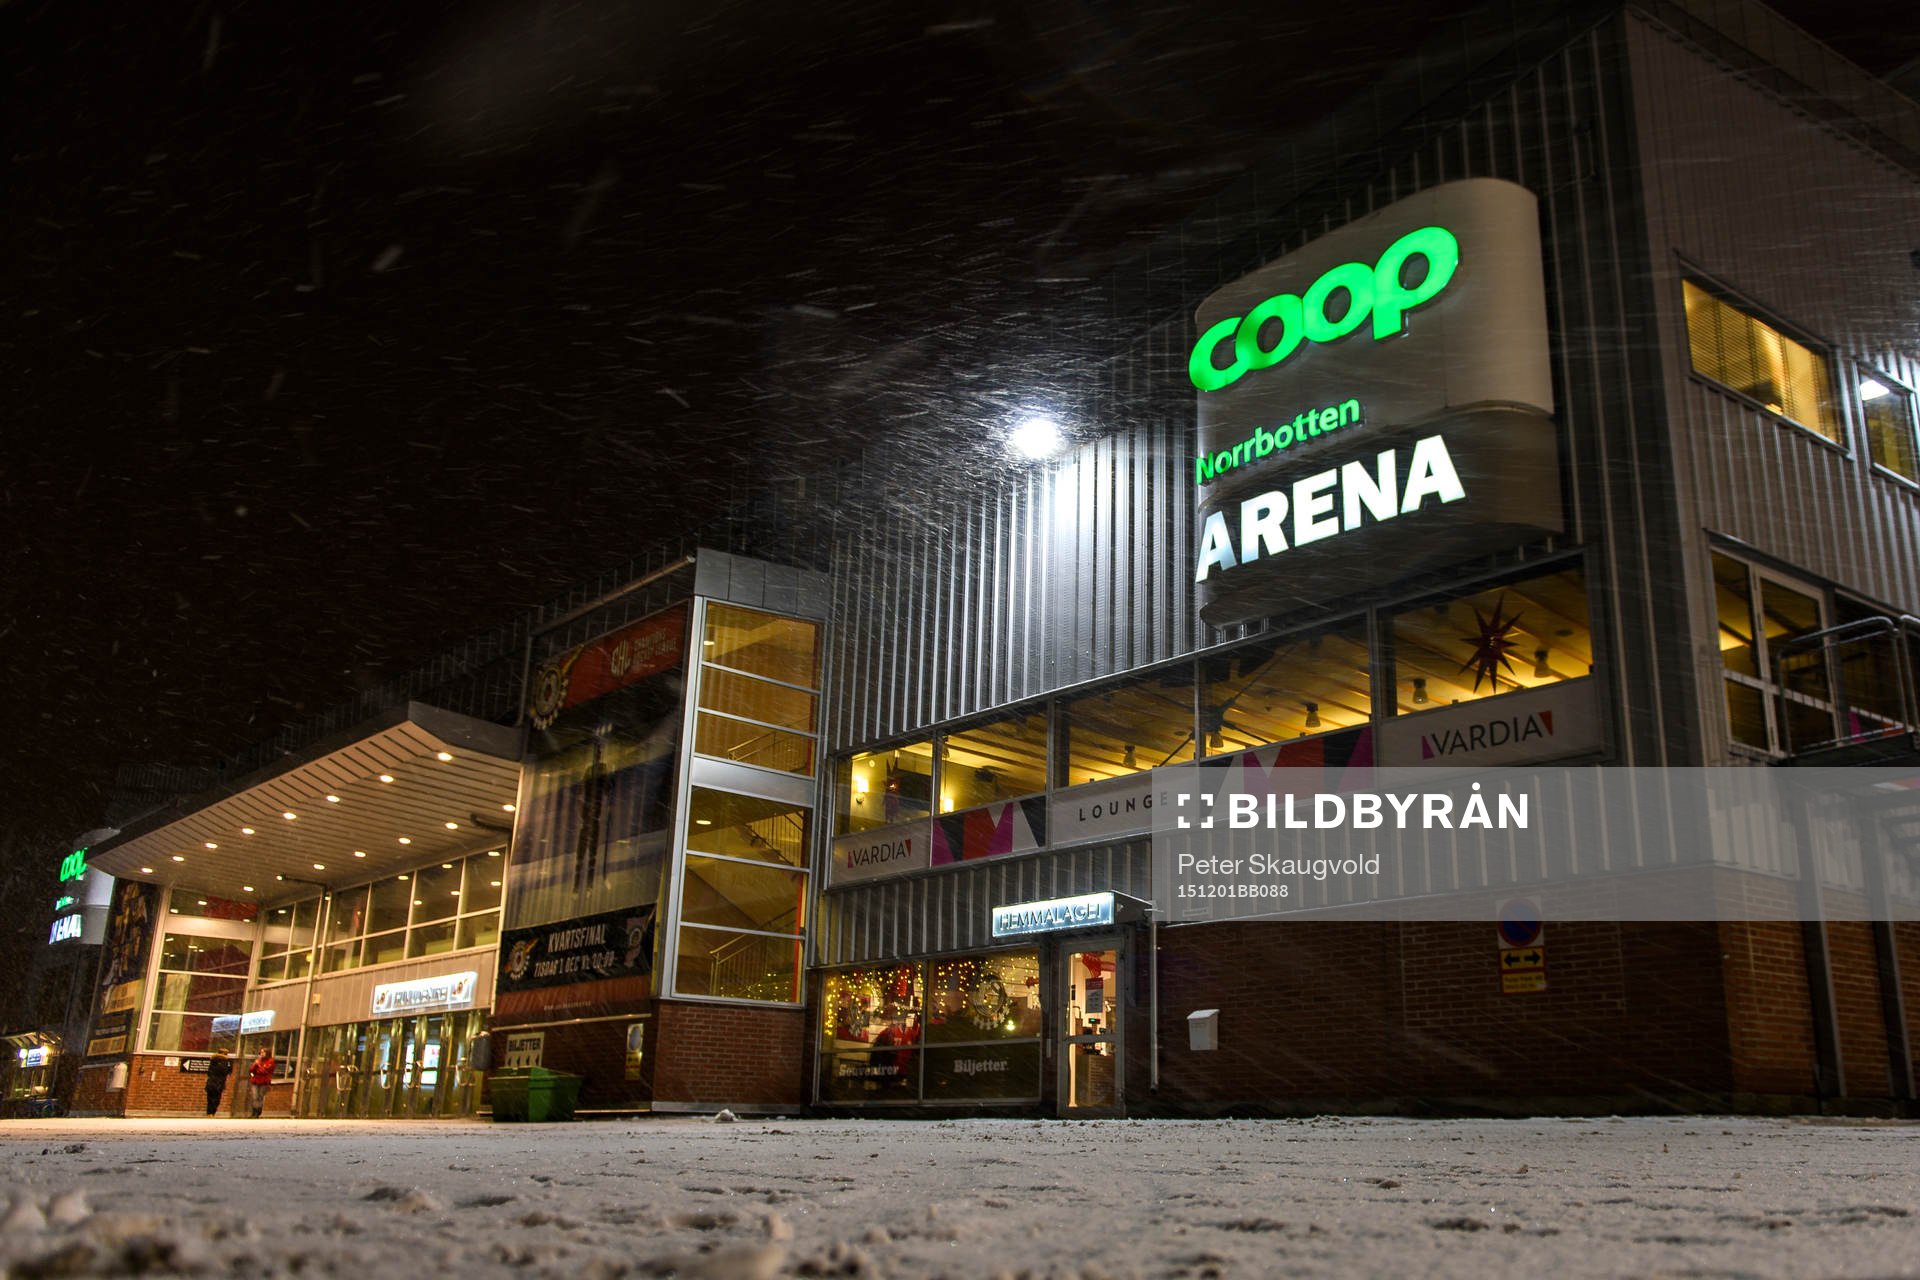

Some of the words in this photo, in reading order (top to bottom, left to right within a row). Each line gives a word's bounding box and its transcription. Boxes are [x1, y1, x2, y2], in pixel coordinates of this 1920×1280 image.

[1189, 226, 1459, 391] coop
[1196, 399, 1360, 486] Norrbotten
[1195, 435, 1466, 582] ARENA
[1430, 714, 1544, 756] VARDIA
[1079, 791, 1168, 822] LOUNGE
[851, 841, 907, 867] VARDIA
[548, 923, 606, 952] KVARTSFINAL
[838, 1062, 899, 1078] Souvenirer
[954, 1058, 1008, 1076] Biljetter
